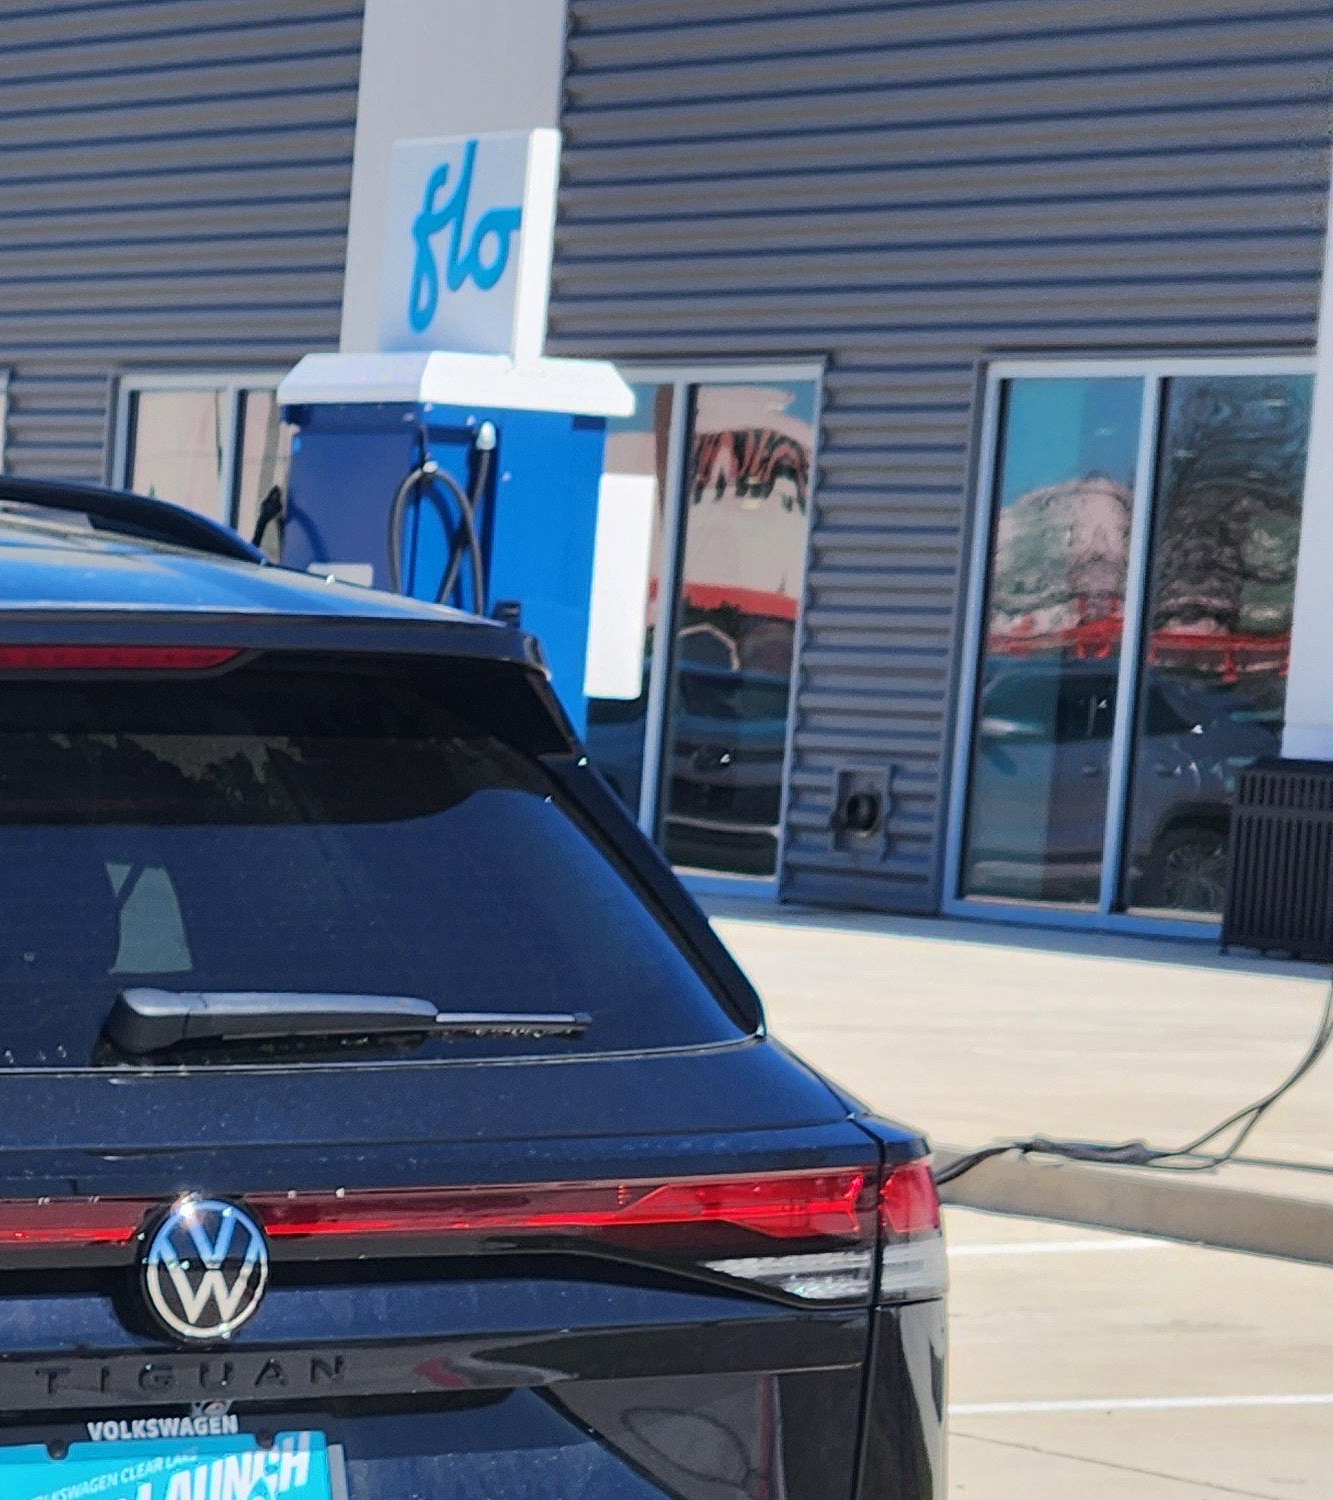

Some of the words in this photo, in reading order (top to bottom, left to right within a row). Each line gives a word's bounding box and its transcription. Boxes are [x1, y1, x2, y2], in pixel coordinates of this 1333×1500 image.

[409, 138, 523, 333] flo
[35, 1355, 344, 1395] TIGUAN
[87, 1414, 238, 1441] VOLKSWAGEN
[120, 1457, 163, 1483] CLEAR
[164, 1448, 199, 1470] LAKE
